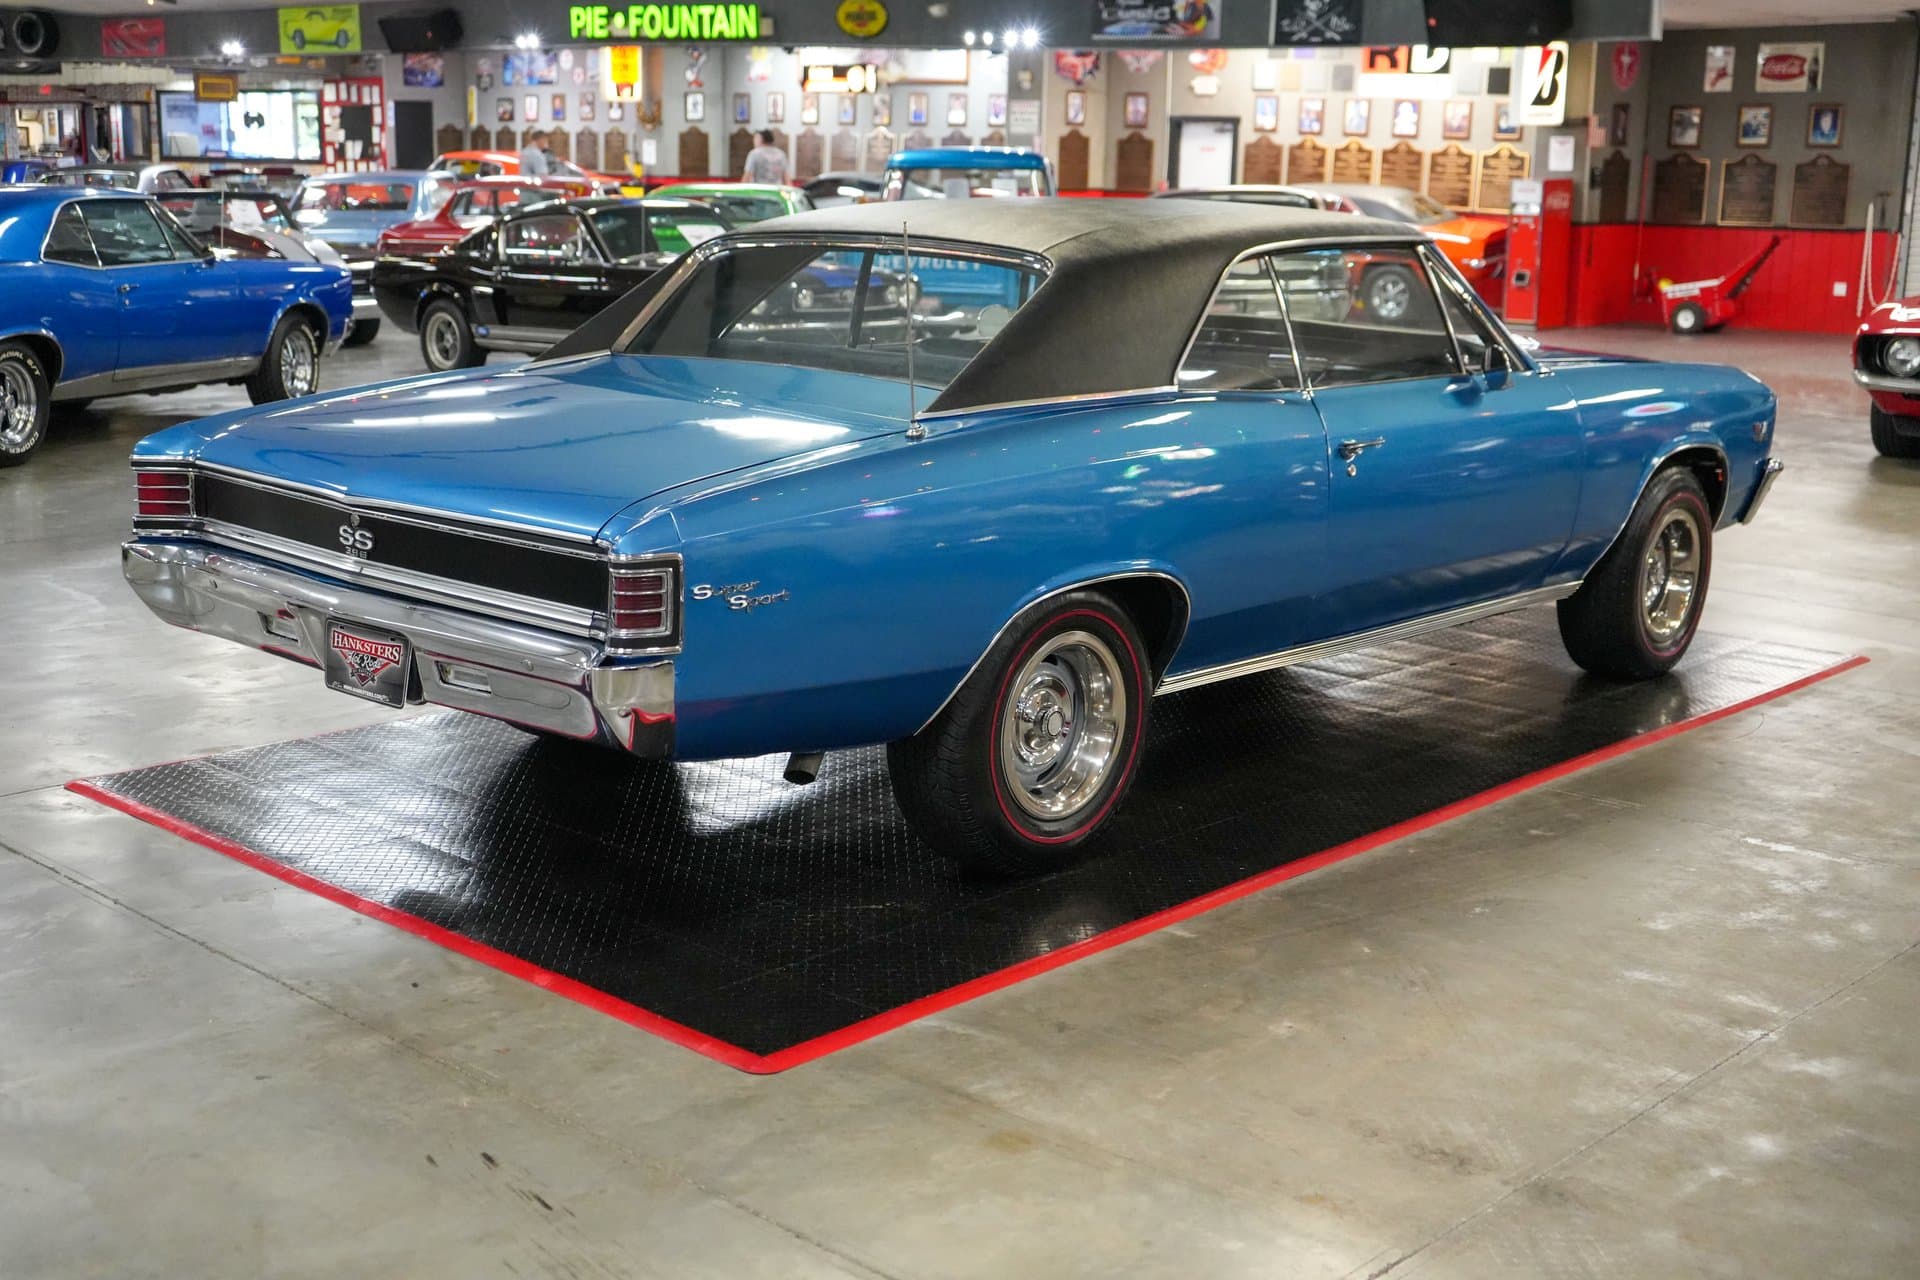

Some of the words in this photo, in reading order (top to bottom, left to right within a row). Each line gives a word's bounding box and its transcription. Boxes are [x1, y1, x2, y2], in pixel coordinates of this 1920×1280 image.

[569, 6, 608, 39] PIE
[628, 4, 758, 39] FOUNTAIN
[339, 525, 374, 550] SS
[691, 580, 760, 600] Super
[728, 589, 790, 614] Sport
[333, 631, 401, 662] HANKSTERS
